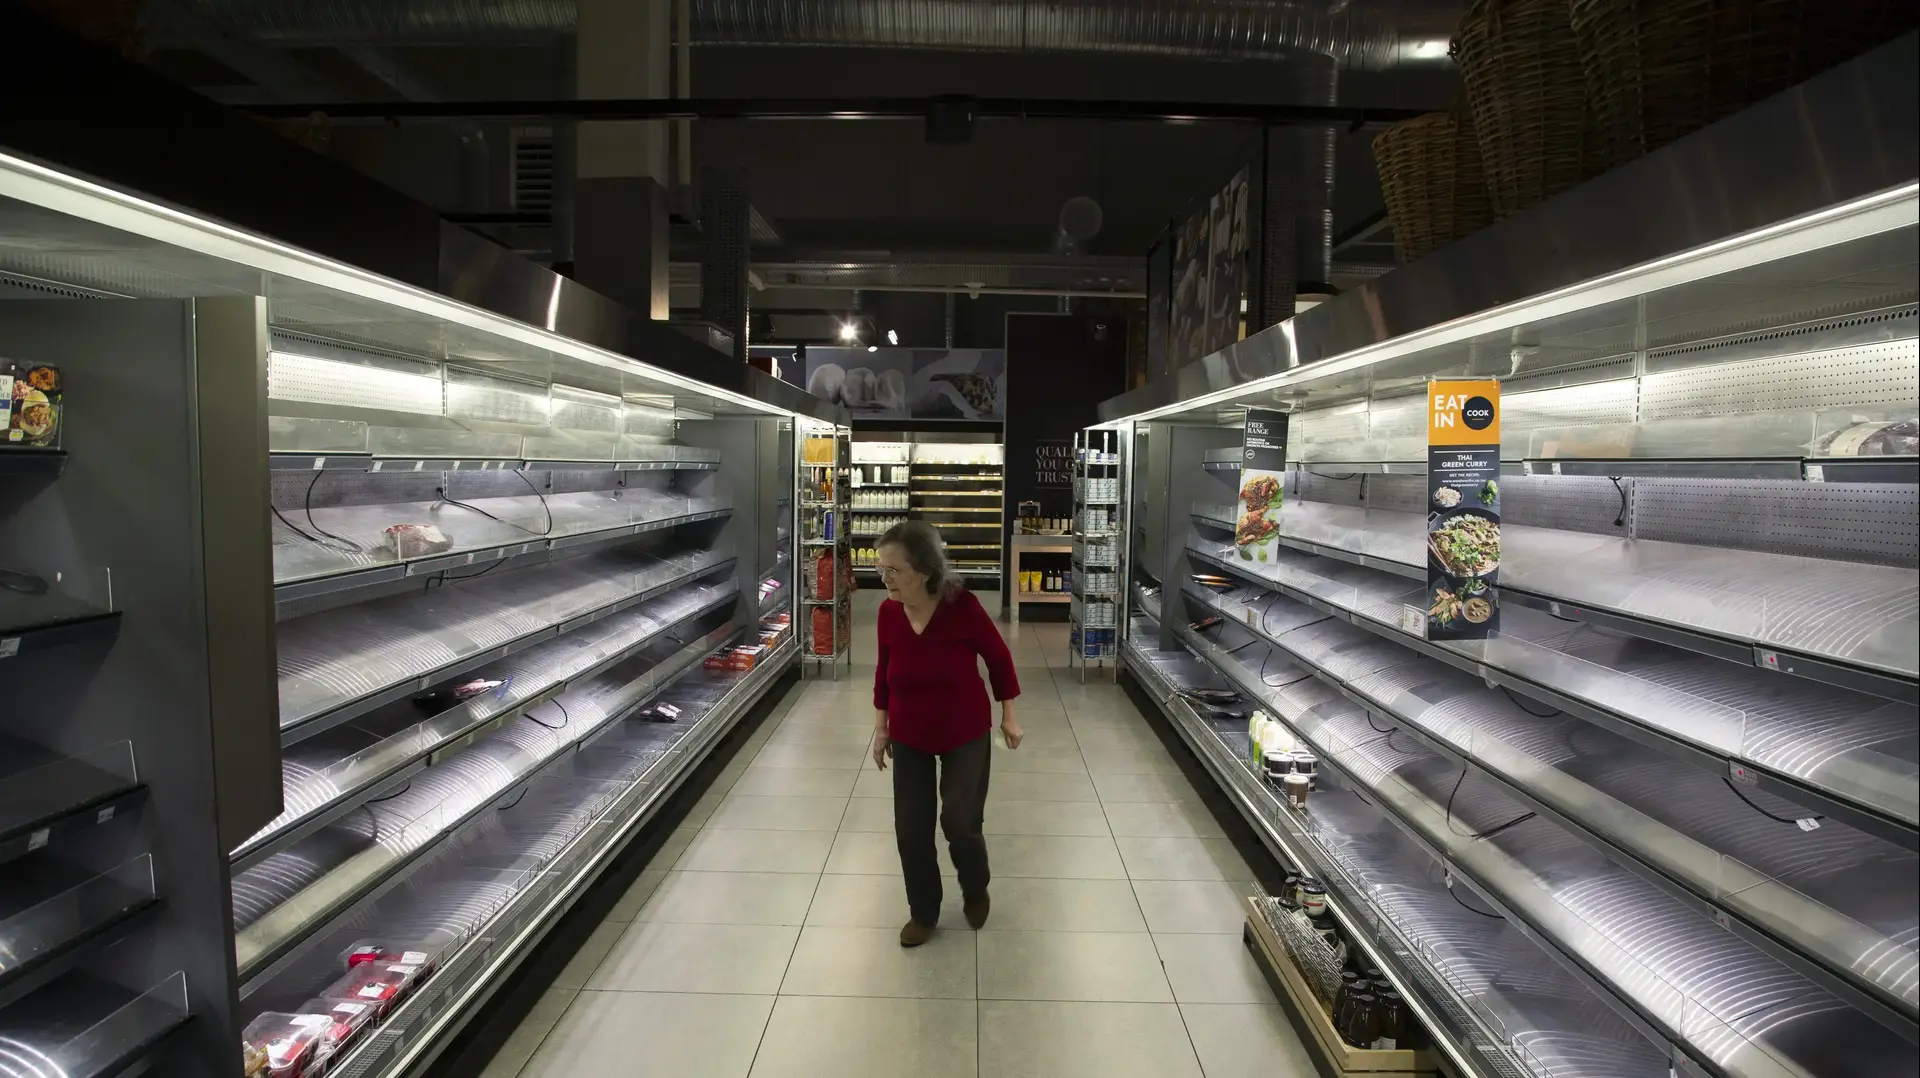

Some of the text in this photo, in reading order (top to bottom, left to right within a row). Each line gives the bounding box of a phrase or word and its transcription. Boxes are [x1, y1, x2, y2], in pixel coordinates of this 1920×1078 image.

[1434, 394, 1468, 410] EAT
[1466, 409, 1490, 417] COOK
[1434, 412, 1455, 428] IN
[1036, 459, 1061, 470] YOU
